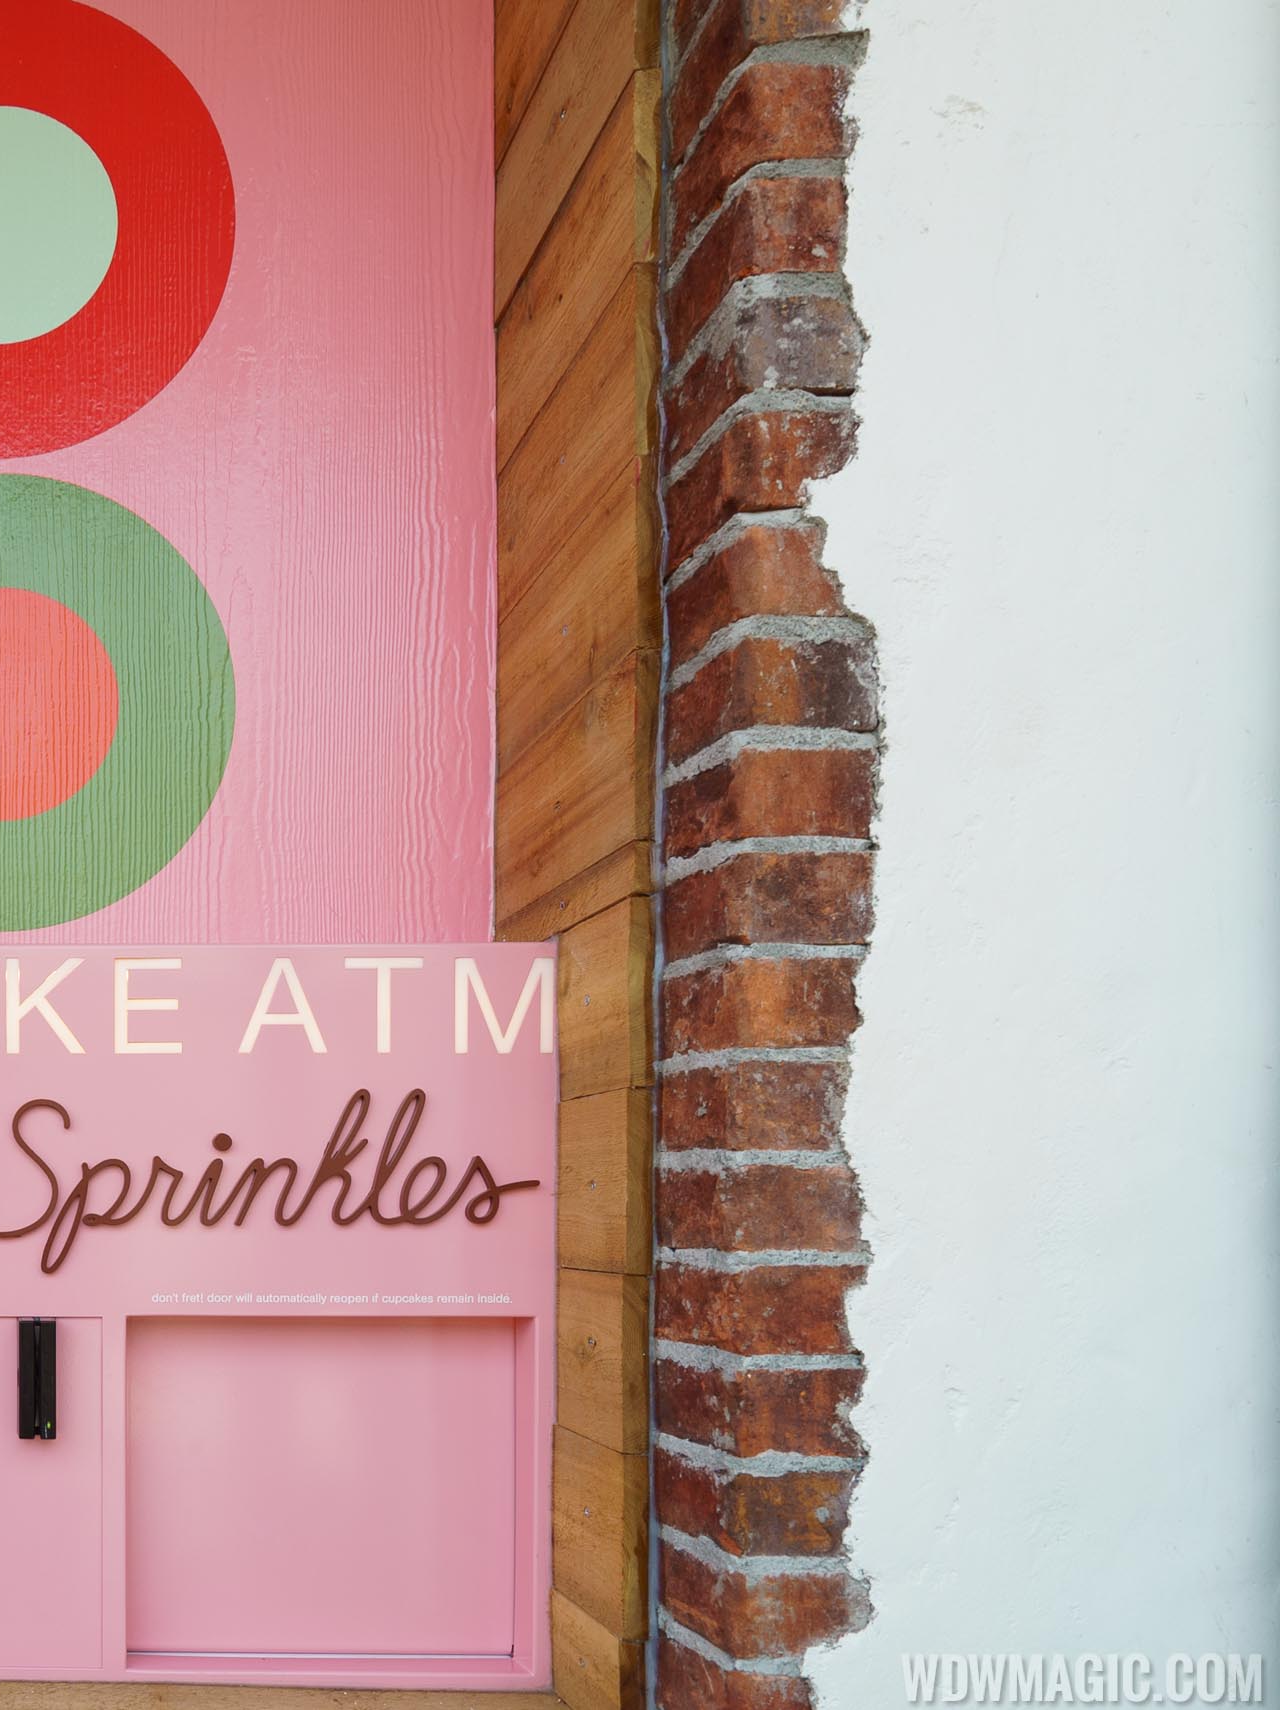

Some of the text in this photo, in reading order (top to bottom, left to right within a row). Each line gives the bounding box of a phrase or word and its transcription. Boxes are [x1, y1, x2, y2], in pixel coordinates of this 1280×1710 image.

[237, 956, 555, 1055] ATM
[151, 1292, 513, 1305] don't fret! door will automatically reopen if cupcakes remain inside.
